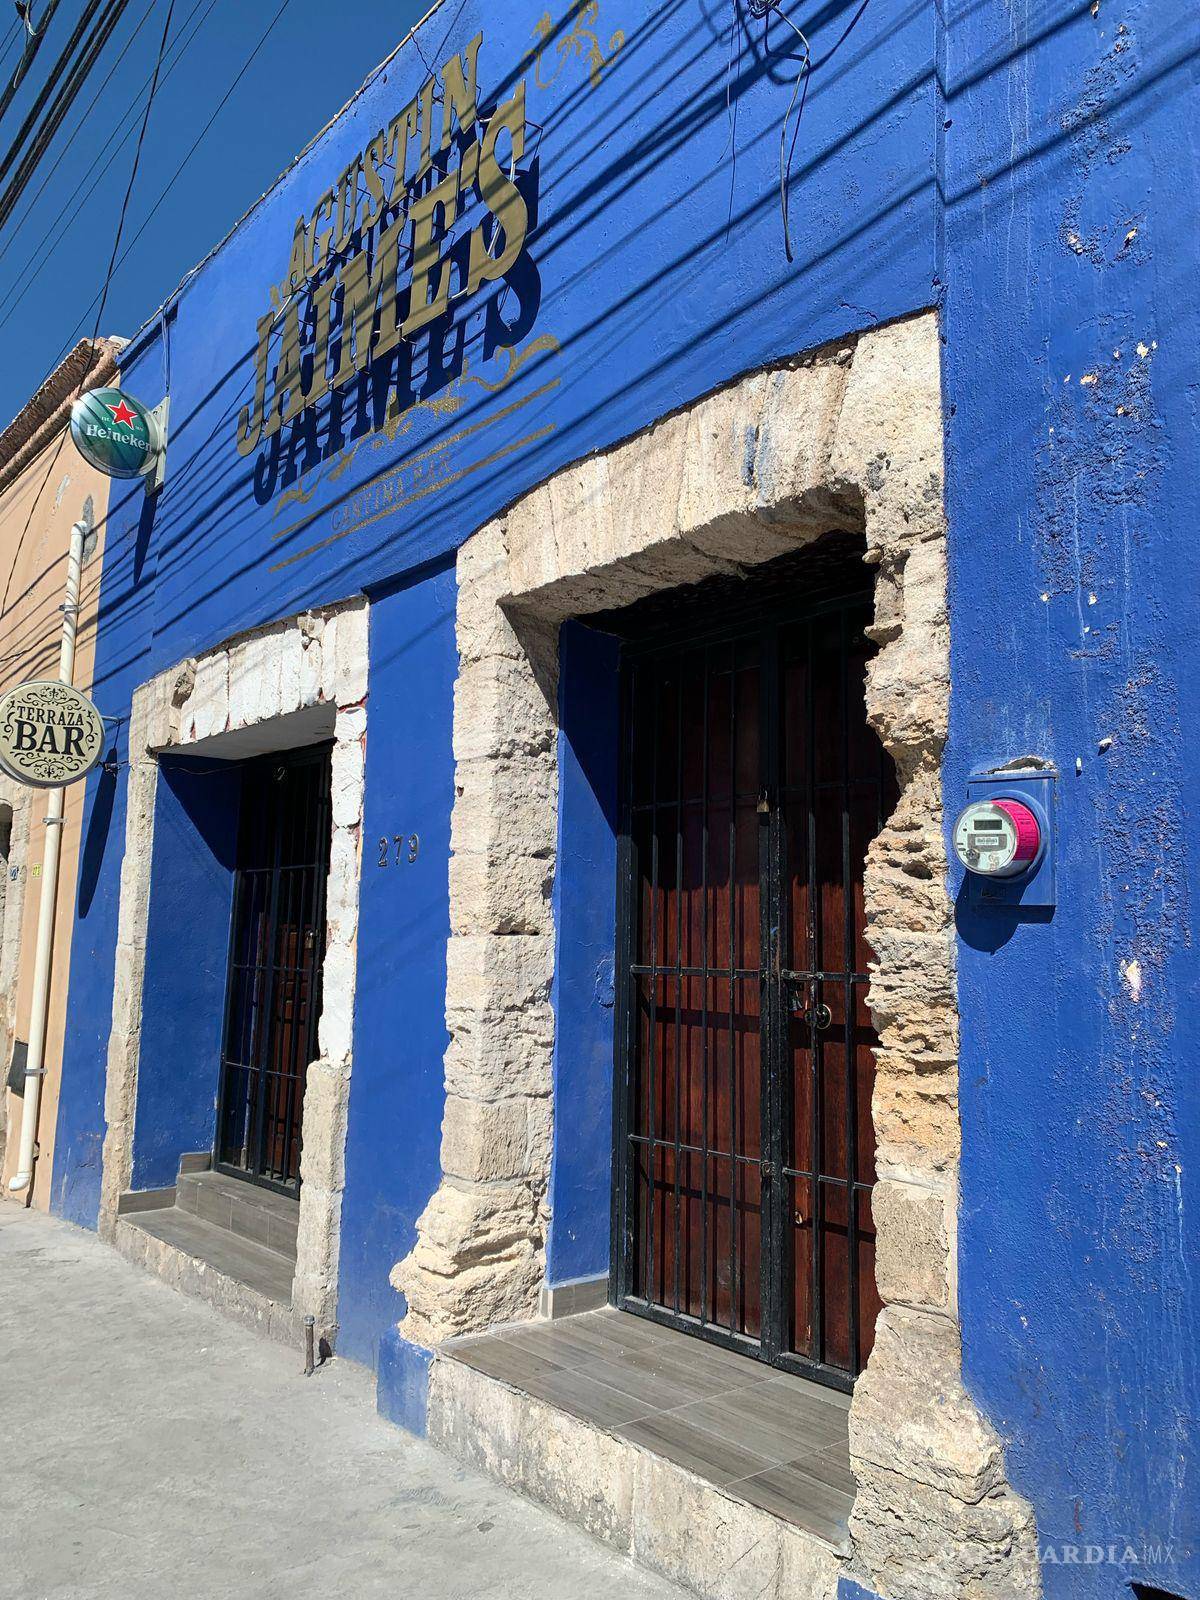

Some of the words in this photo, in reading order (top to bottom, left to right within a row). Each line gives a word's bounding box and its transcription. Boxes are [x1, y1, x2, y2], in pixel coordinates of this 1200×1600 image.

[283, 31, 483, 298] AGUSTIN
[237, 79, 527, 457] JAIMES
[86, 423, 153, 453] Heineken
[17, 706, 84, 726] TERRAZA
[12, 719, 86, 757] BAR
[378, 833, 419, 867] 279
